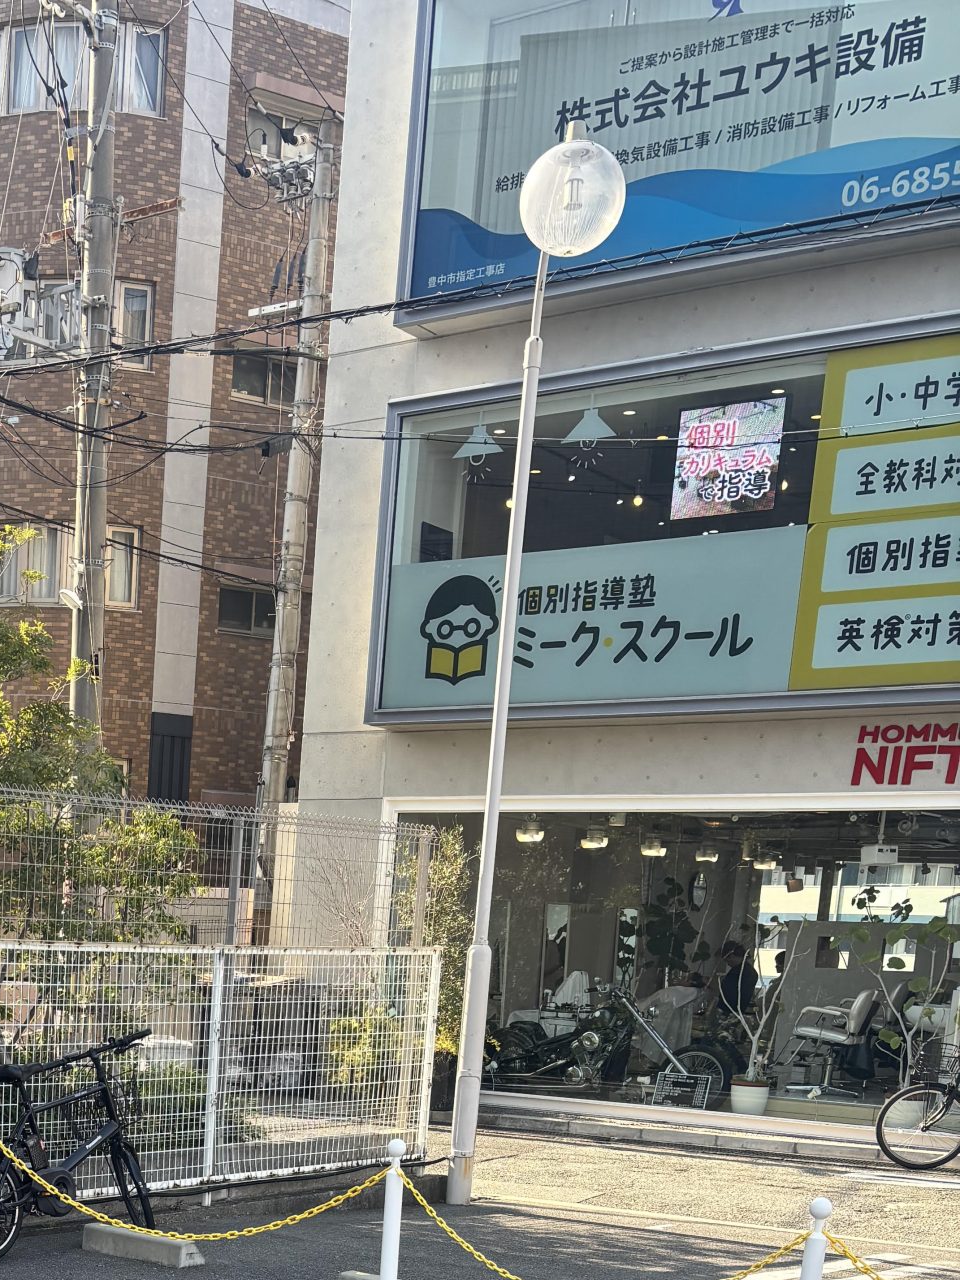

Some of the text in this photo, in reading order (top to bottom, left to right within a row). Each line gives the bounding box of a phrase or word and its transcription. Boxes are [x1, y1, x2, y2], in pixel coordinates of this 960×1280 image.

[619, 4, 856, 75] ご提案から設計施工管理まで一括対応
[554, 15, 927, 142] 株式会社ユウキ設備
[611, 131, 711, 166] 換気設備工事
[686, 420, 738, 450] 個別
[682, 449, 772, 476] カリキュラム
[700, 470, 769, 500] で指導
[846, 533, 960, 575] 個別指
[518, 573, 656, 615] 個別指導塾
[513, 613, 754, 668] ミーク・スクール
[858, 722, 960, 743] HOMM
